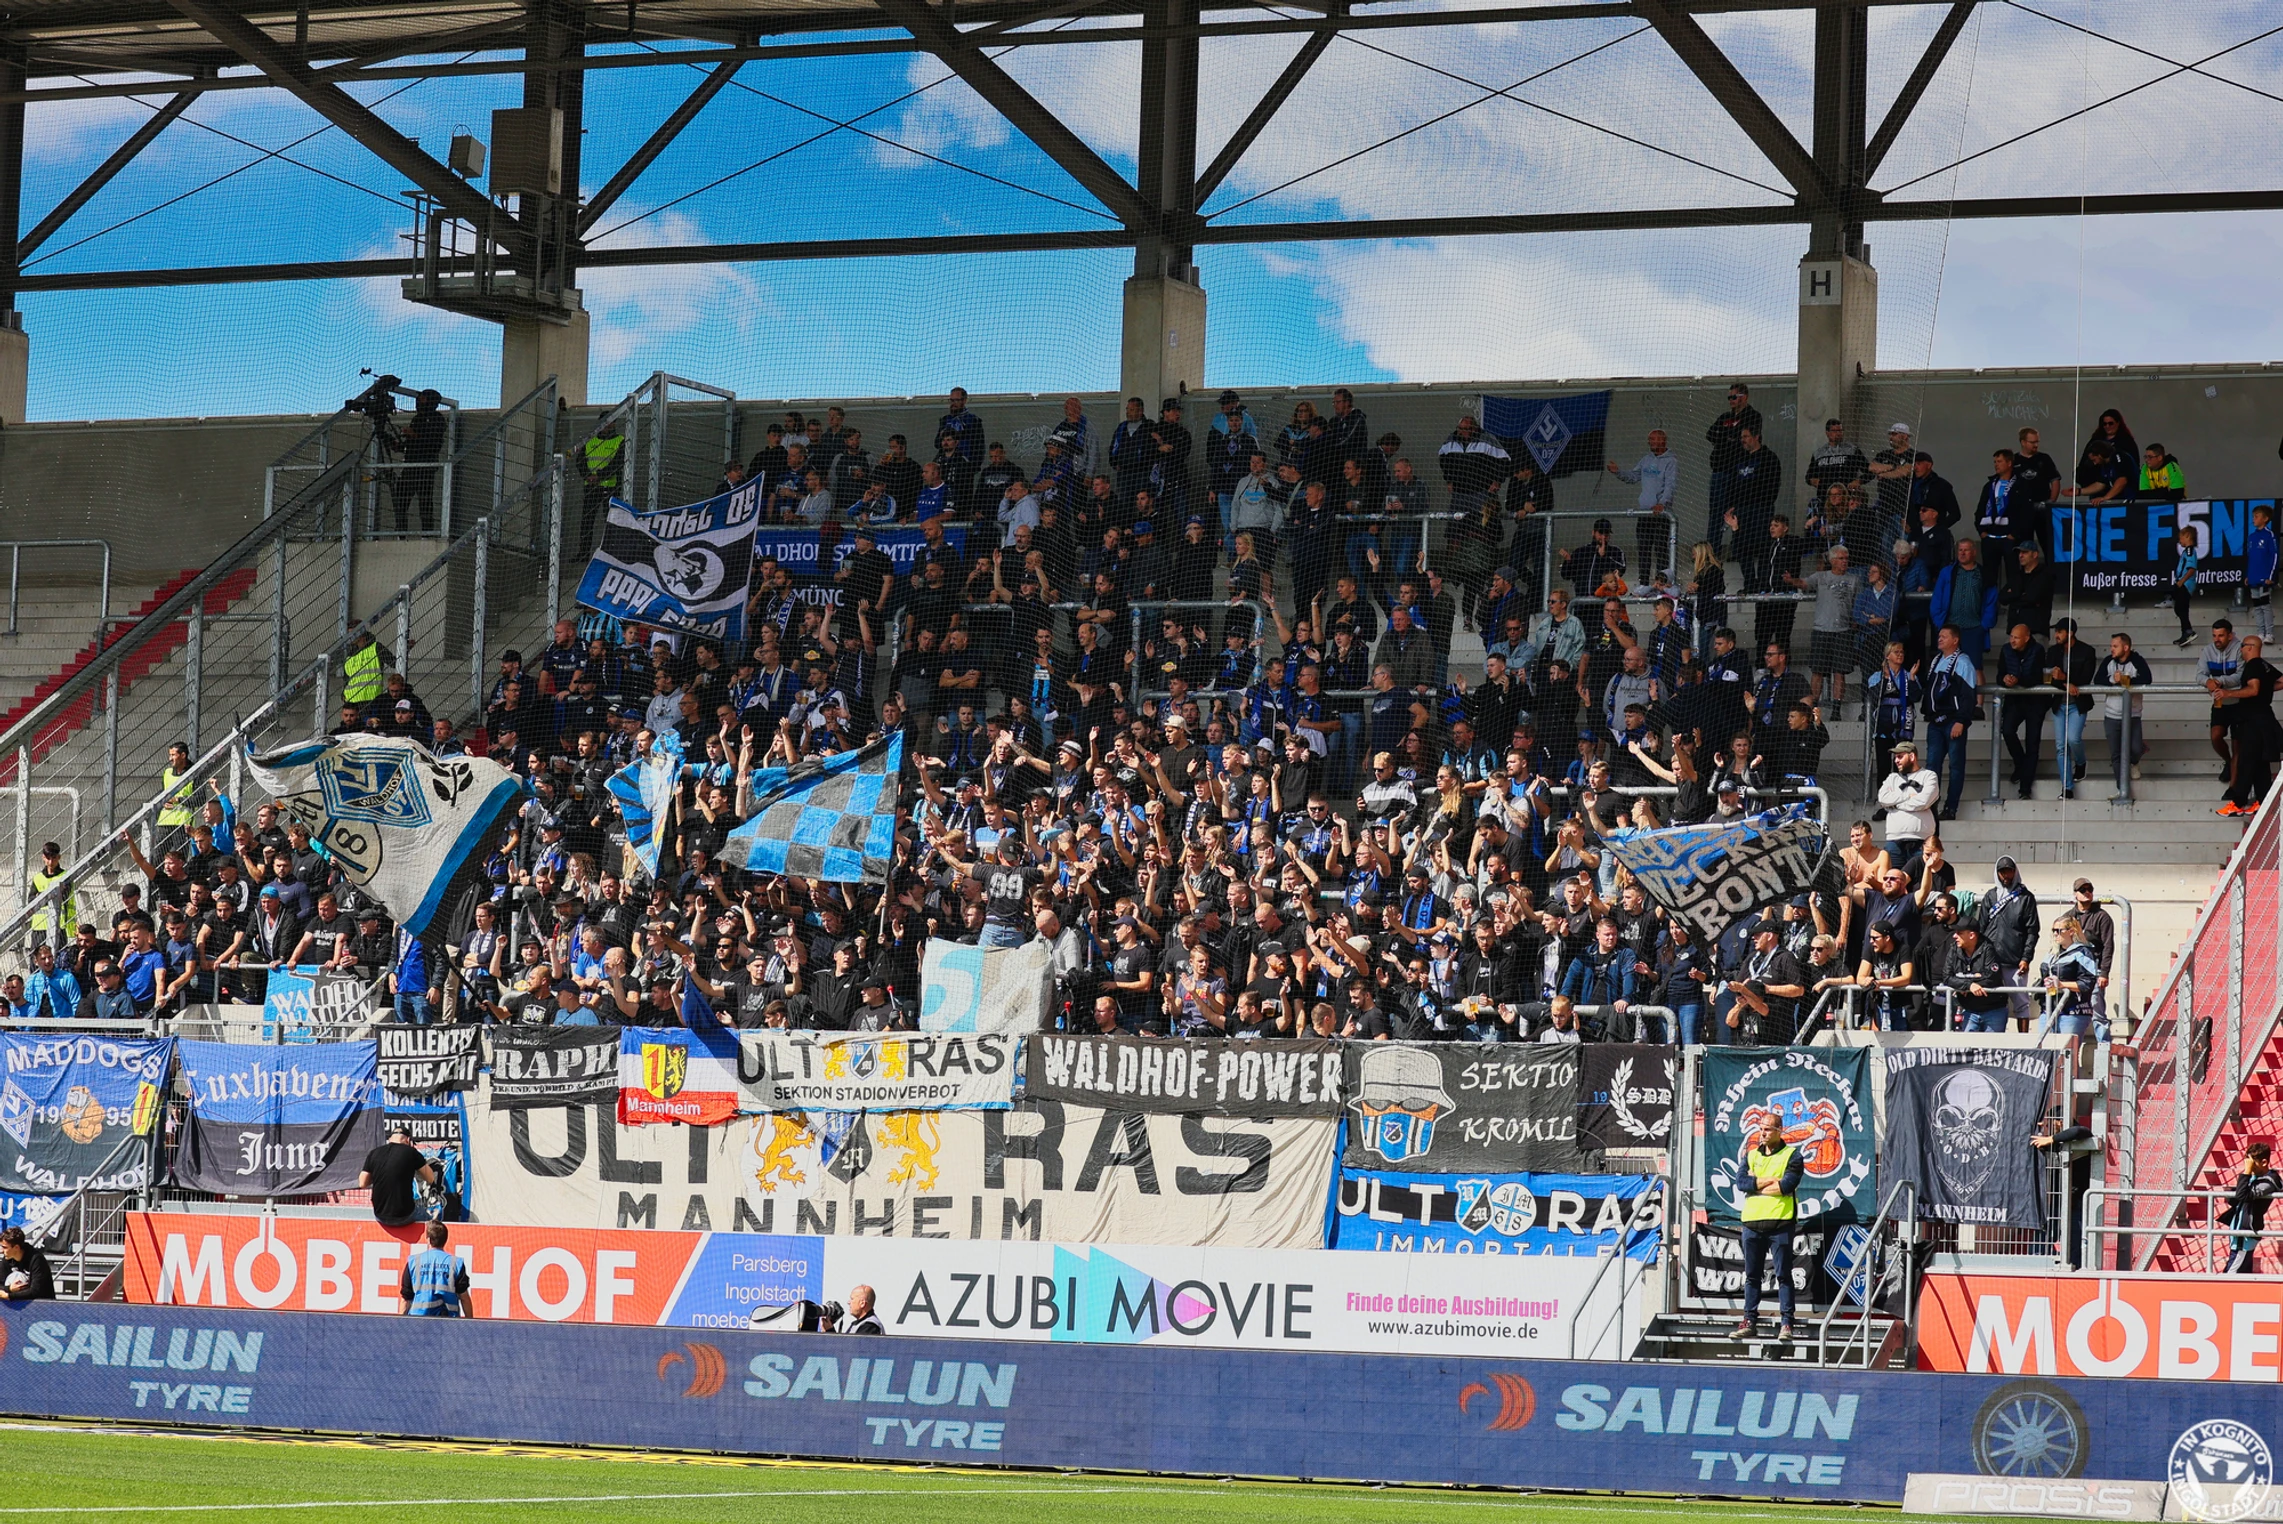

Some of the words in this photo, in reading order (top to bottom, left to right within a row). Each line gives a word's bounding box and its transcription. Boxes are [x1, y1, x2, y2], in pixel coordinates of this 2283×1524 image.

[1810, 270, 1831, 297] H
[2052, 507, 2127, 563] DIE
[755, 543, 820, 562] ALDHO
[2083, 573, 2117, 590] Außer
[2120, 571, 2157, 587] fresse
[359, 771, 402, 807] WALDHOF
[382, 789, 409, 816] 07
[6, 1040, 162, 1080] MADDOGS
[907, 1033, 1006, 1081] RAS
[1887, 1051, 1917, 1074] OLD
[376, 1063, 434, 1089] SECHS
[1460, 1061, 1578, 1094] SEKTIO
[774, 1084, 833, 1101] SEKTION
[835, 1083, 961, 1101] STADIONVERBOT
[36, 1105, 59, 1125] 19
[106, 1106, 132, 1127] 95
[626, 1095, 701, 1117] Mannheim
[236, 1131, 330, 1174] Jung
[1336, 1176, 1445, 1227] ULT
[1917, 1203, 2008, 1222] MANNHEIM
[617, 1191, 1042, 1241] MANNHEIM
[1494, 1210, 1505, 1224] 6
[1512, 1215, 1522, 1231] 8
[1792, 1233, 1824, 1256] OF
[157, 1216, 637, 1323] MÖBEHOF
[732, 1254, 807, 1277] Parsberg
[1695, 1266, 1807, 1292] WOS
[725, 1282, 806, 1304] Ingolstadt
[896, 1270, 1075, 1331] AZUBI
[1106, 1276, 1313, 1339] MOVIE
[1346, 1292, 1393, 1312] Finde
[1397, 1294, 1447, 1315] deine
[1451, 1296, 1559, 1320] Ausbildung!
[692, 1311, 749, 1328] moebe
[1368, 1320, 1538, 1339] www.azubimovie.de
[22, 1320, 264, 1374] SAILUN
[743, 1353, 1017, 1408] SAILUN
[129, 1380, 253, 1414] TYRE
[1555, 1384, 1860, 1441] SAILUN
[865, 1417, 1006, 1450] TYRE
[1690, 1450, 1846, 1486] TYRE
